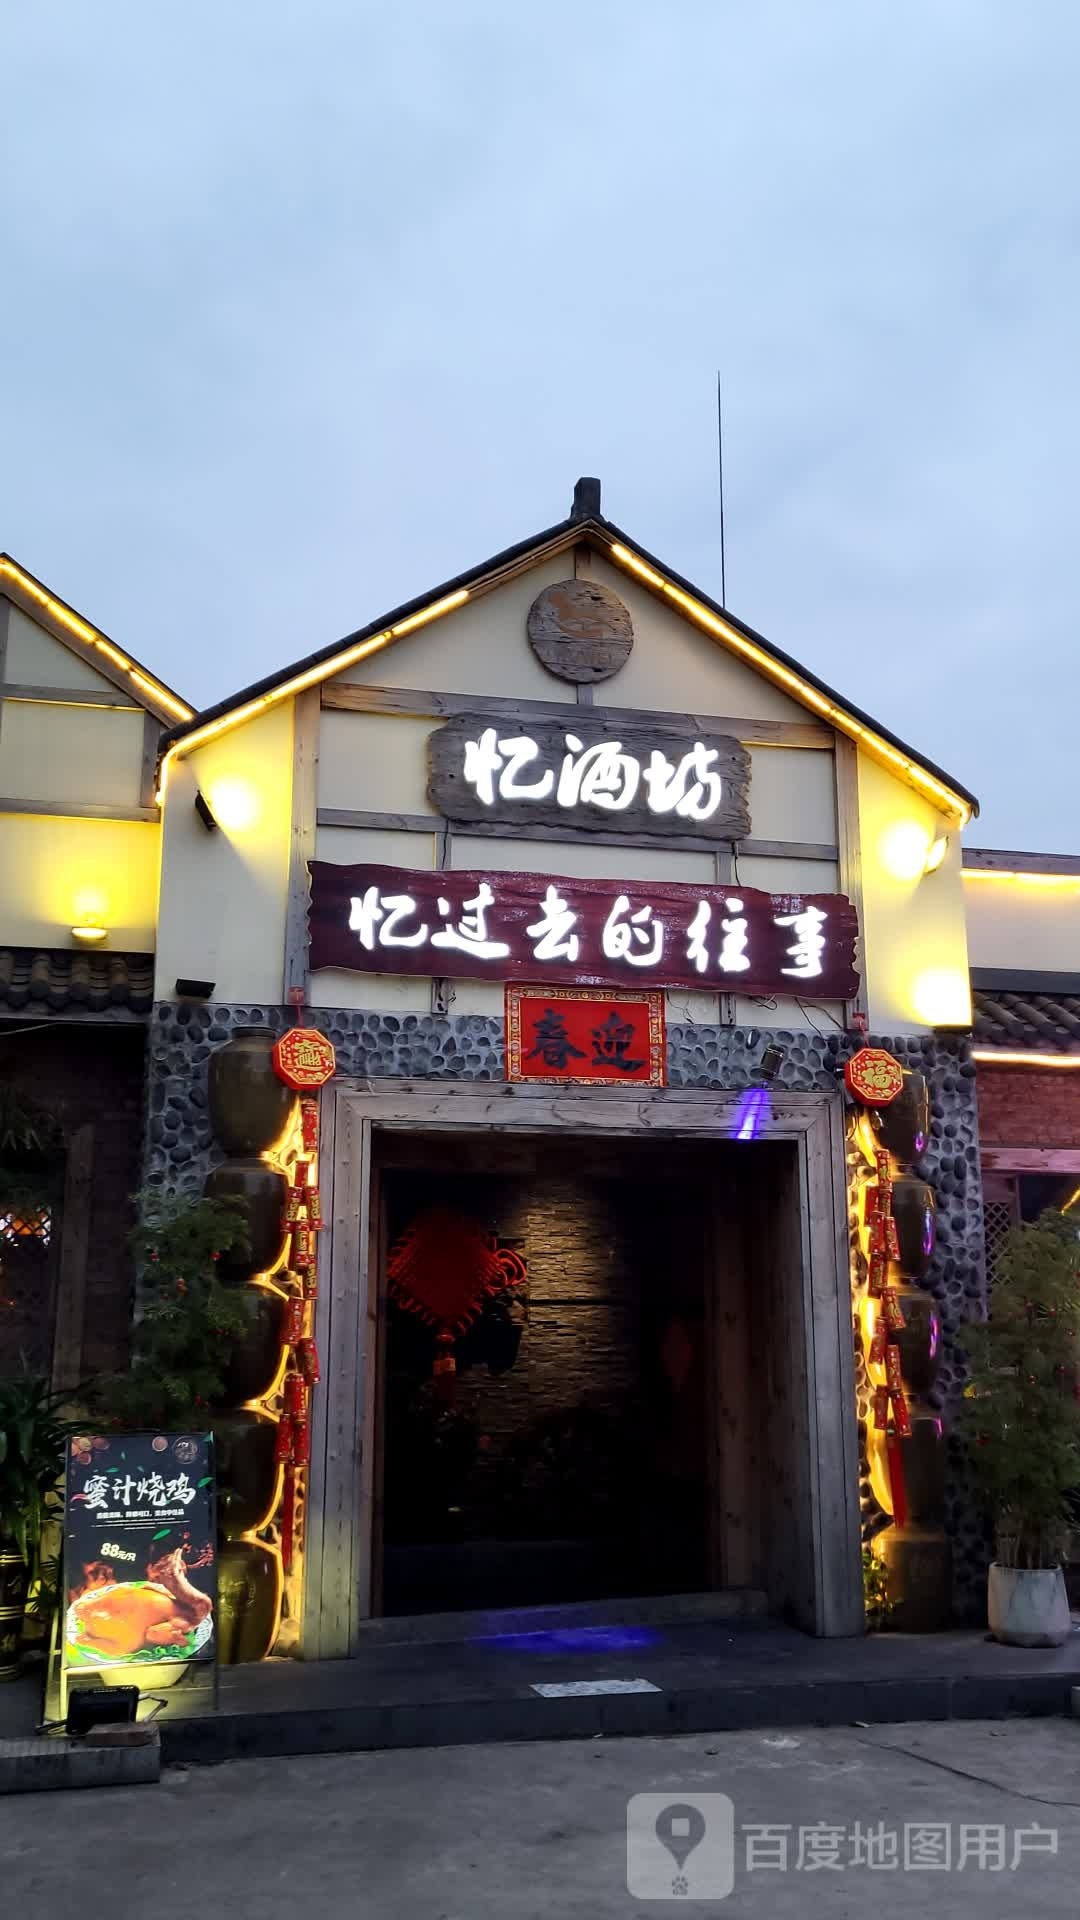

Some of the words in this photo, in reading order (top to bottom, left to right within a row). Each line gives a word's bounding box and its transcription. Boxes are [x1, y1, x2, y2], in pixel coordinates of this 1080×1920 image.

[463, 727, 722, 821] 忆酒坊
[347, 881, 829, 979] 忆过去的往事
[83, 1471, 197, 1509] 蜜汁烧鸡
